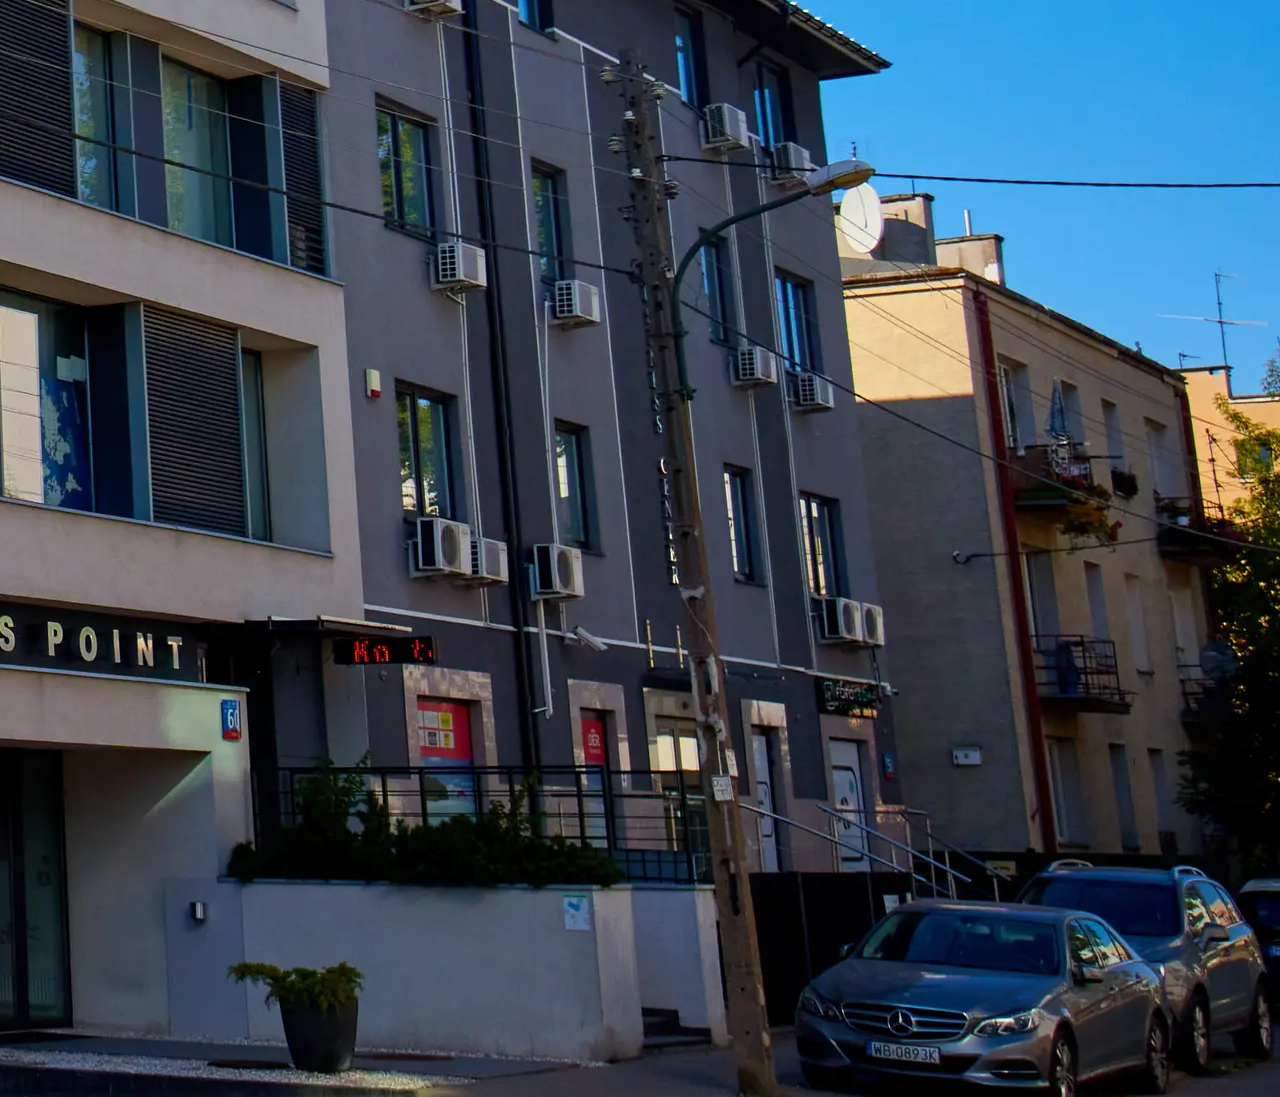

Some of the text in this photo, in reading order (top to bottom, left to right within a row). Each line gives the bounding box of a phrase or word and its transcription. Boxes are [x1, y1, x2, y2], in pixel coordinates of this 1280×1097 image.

[46, 620, 184, 671] POINT
[873, 1043, 936, 1062] WB 0893K
